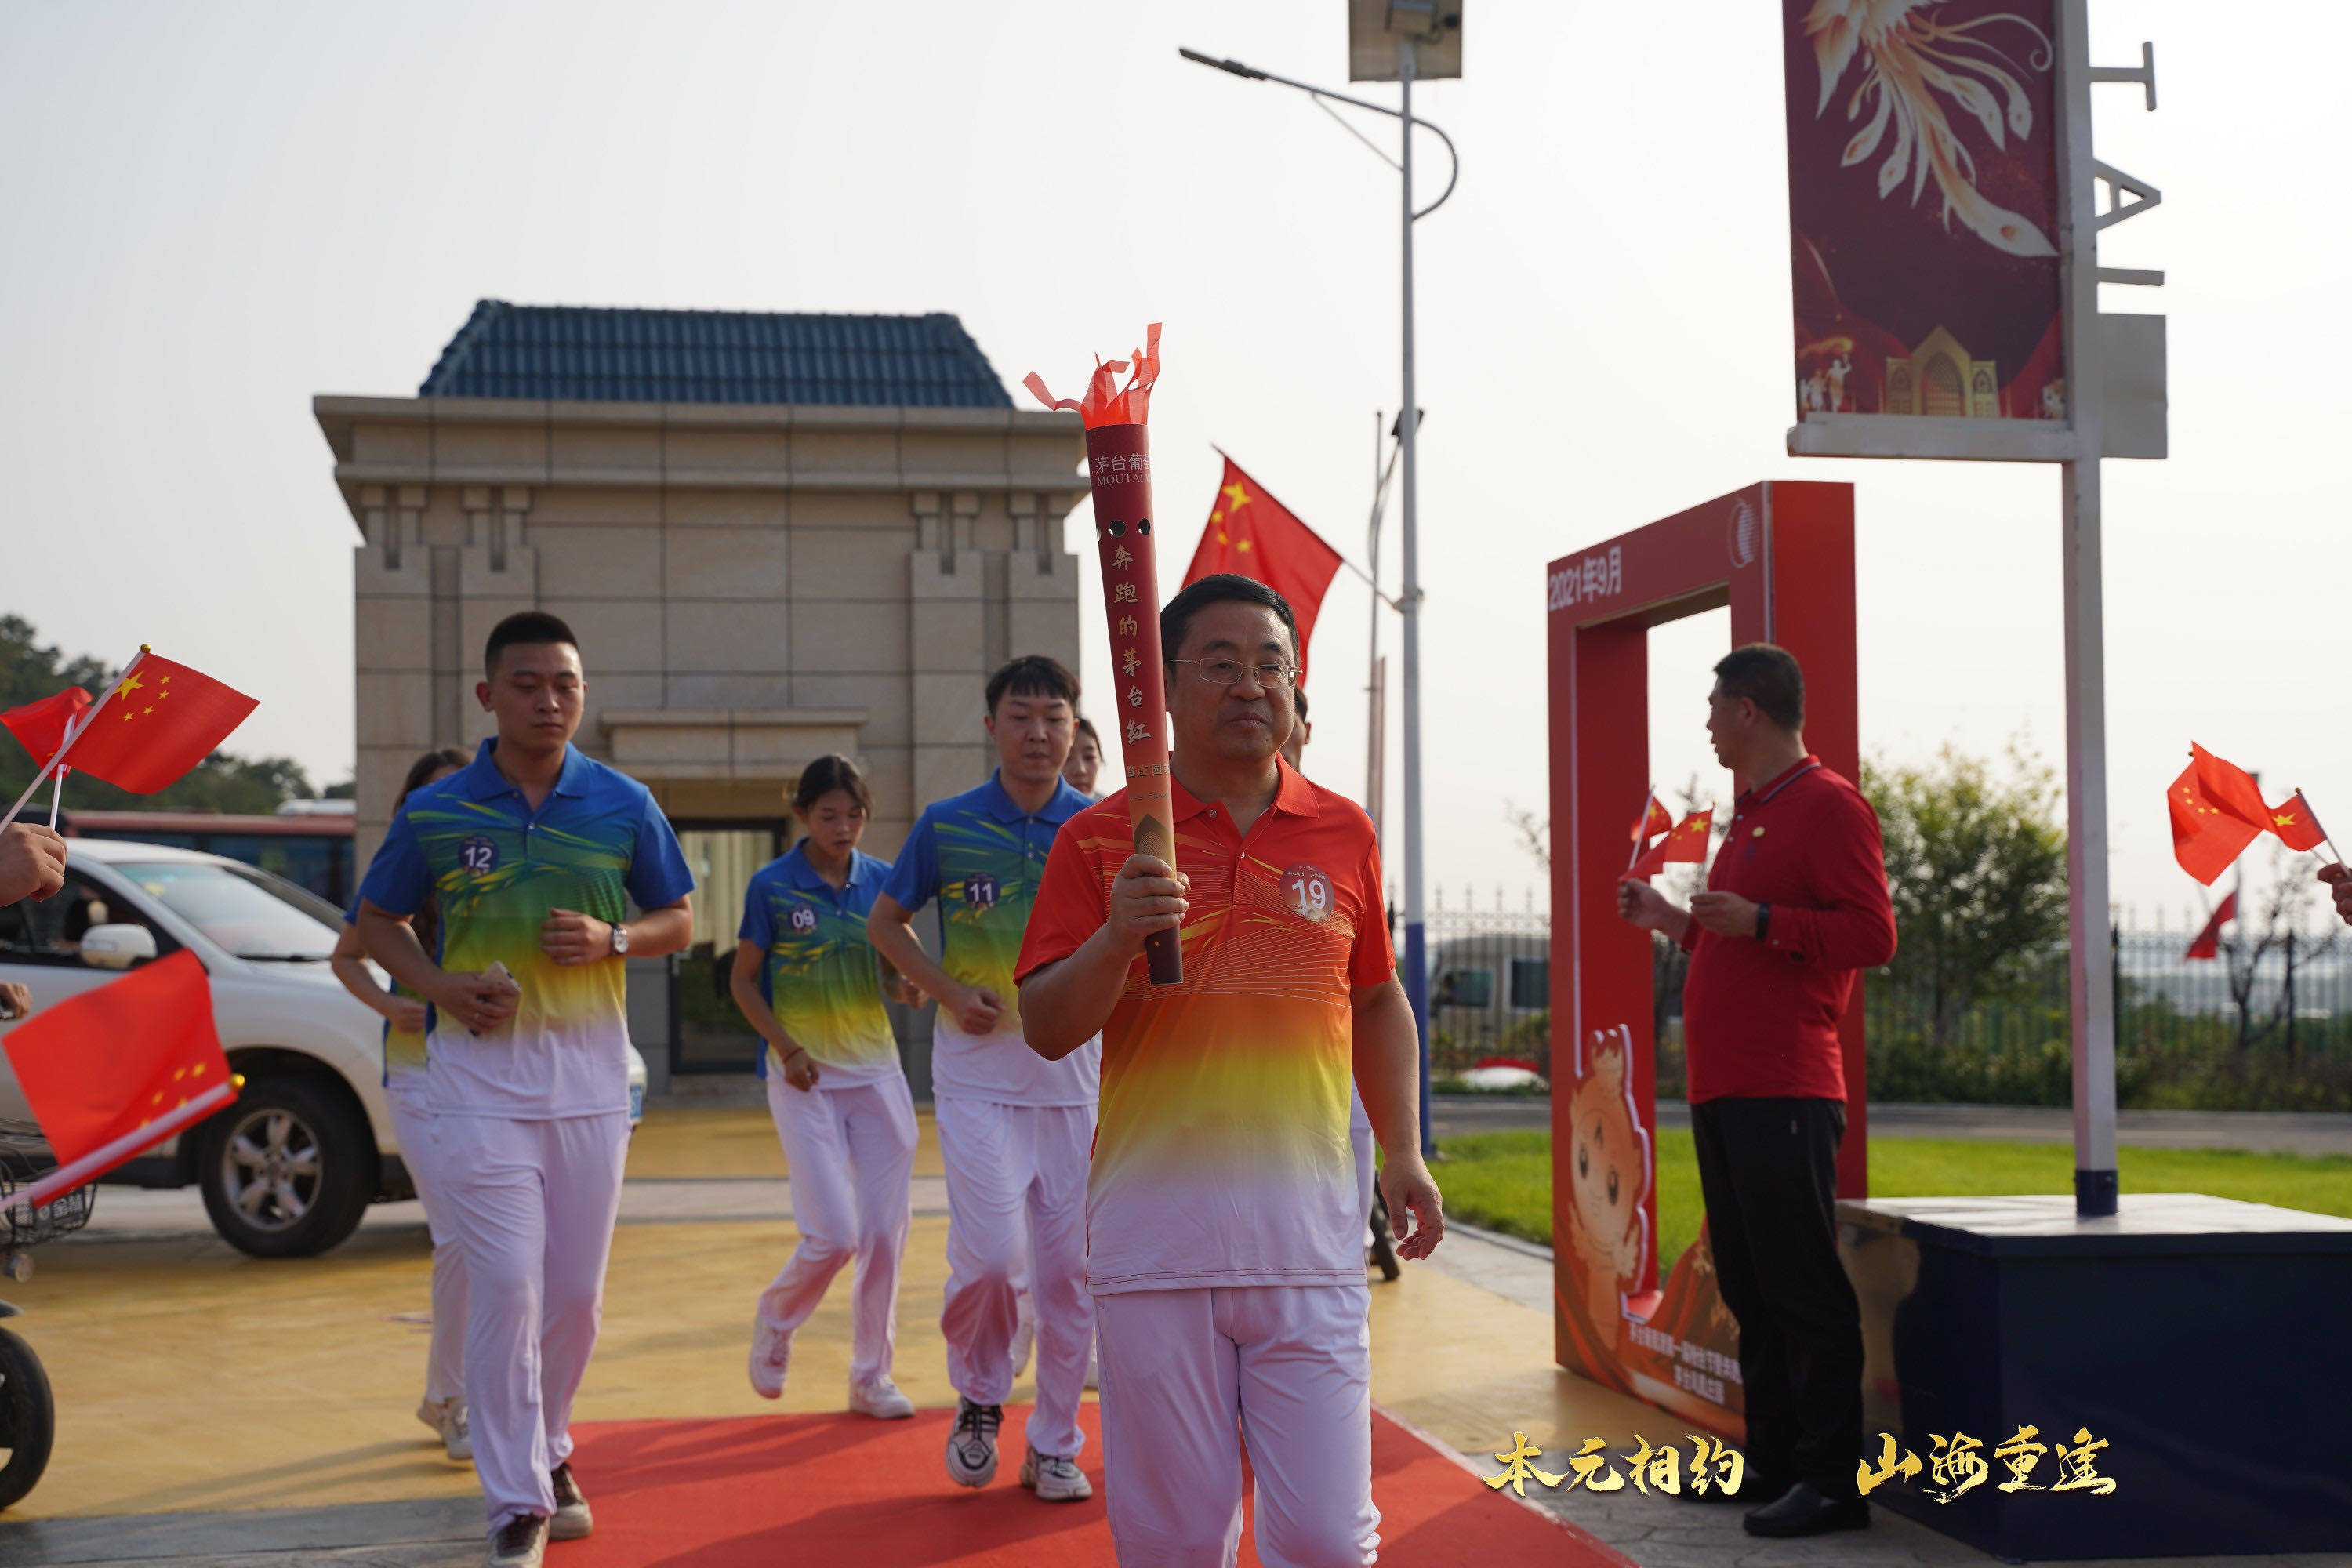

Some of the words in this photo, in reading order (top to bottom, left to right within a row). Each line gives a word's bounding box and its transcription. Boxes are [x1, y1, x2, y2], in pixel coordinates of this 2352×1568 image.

[1098, 473, 1143, 486] MOUTAI
[1548, 546, 1622, 612] 2021年9月
[1110, 543, 1152, 745] 奔跑的茅台红
[465, 847, 492, 868] 12
[970, 882, 993, 902] 11
[1291, 879, 1326, 916] 19
[792, 909, 815, 928] 09
